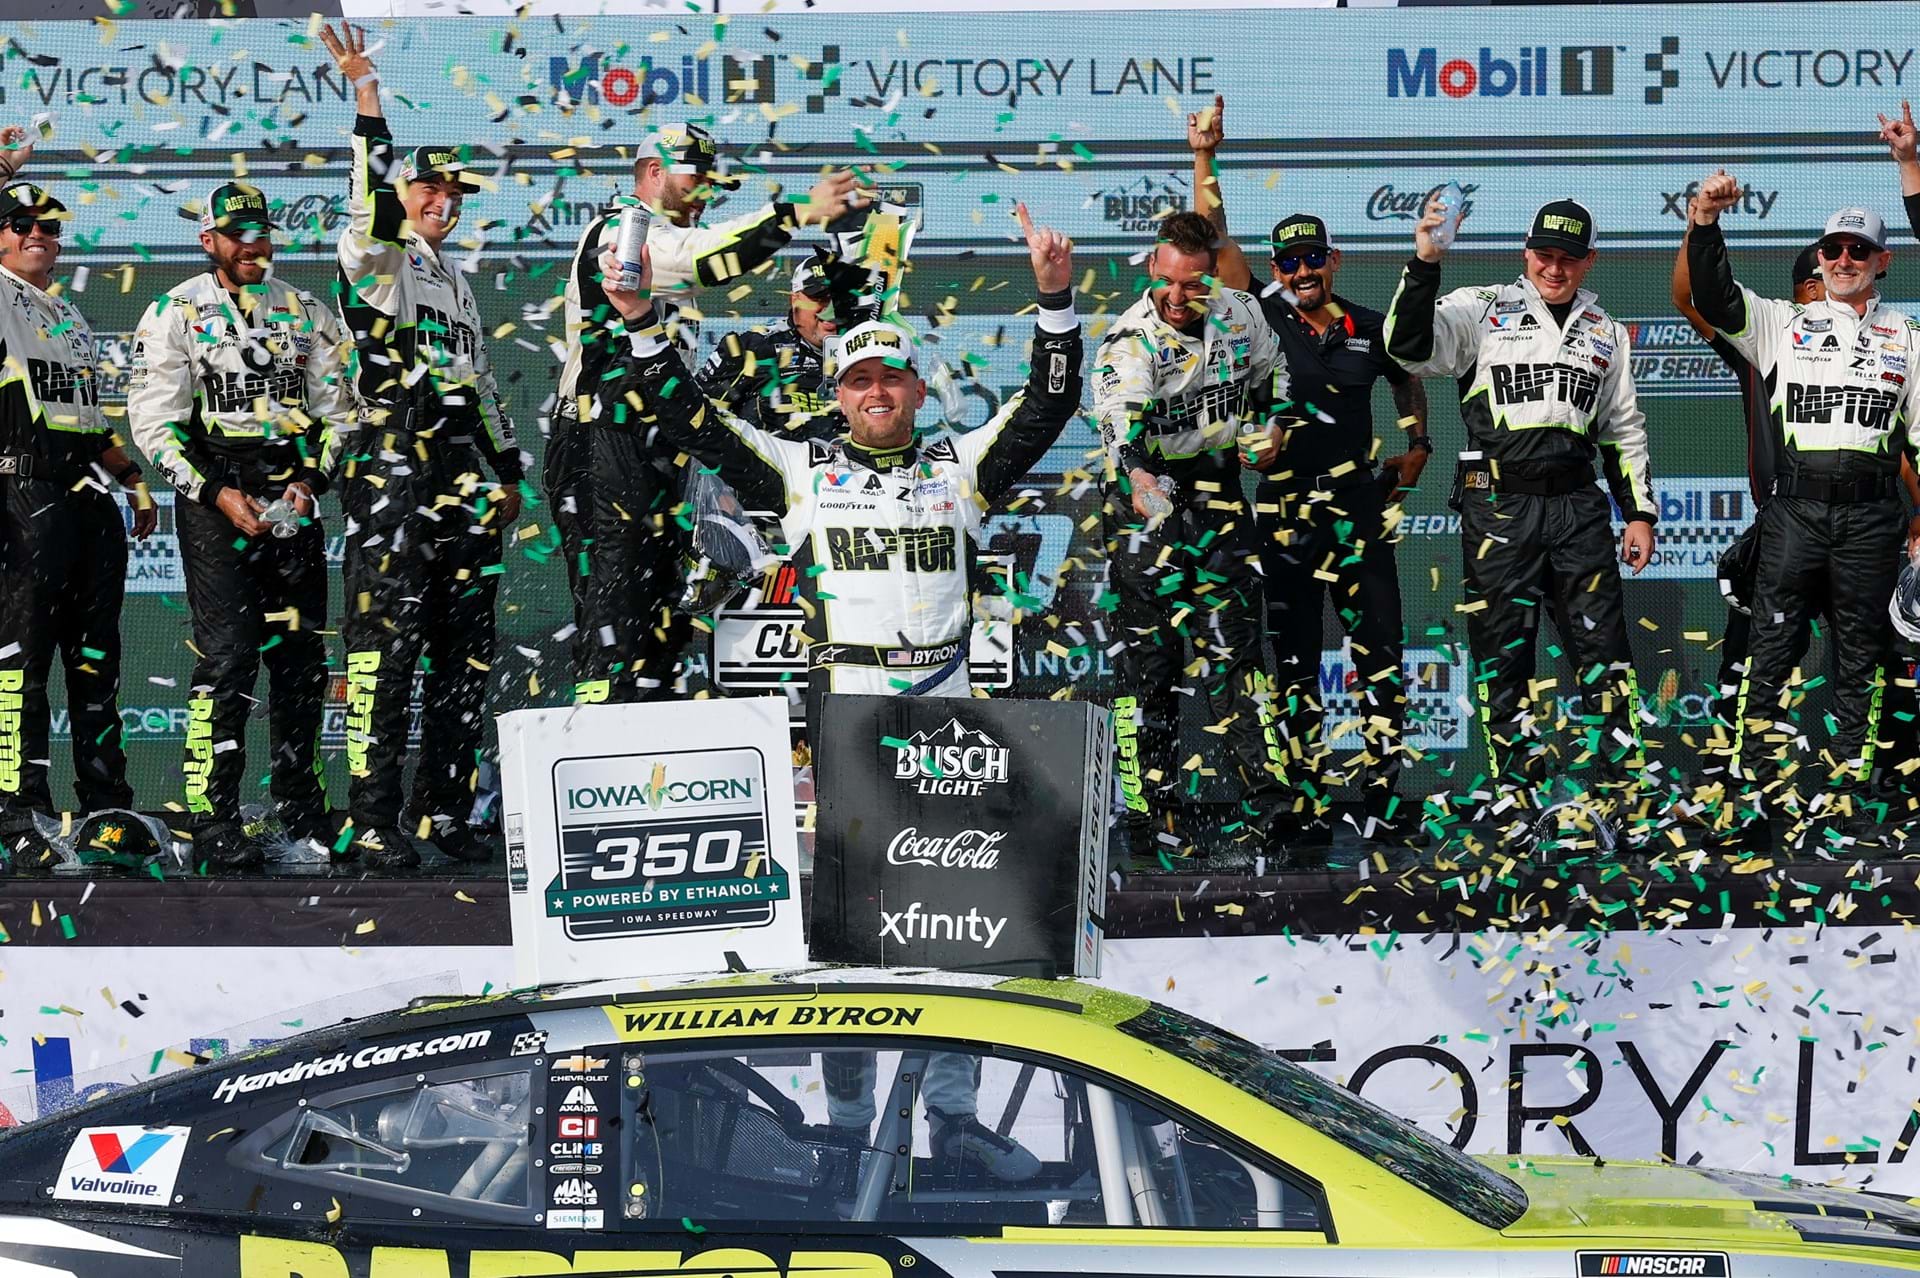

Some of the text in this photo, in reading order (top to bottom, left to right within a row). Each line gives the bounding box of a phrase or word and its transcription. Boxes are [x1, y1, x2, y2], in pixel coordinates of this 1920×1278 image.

[549, 56, 709, 105] Mobil
[866, 56, 1215, 97] VICTORY LANE
[1386, 47, 1547, 98] Mobil
[1704, 48, 1914, 89] VICTORY
[31, 63, 357, 105] VICTORY LAN
[224, 195, 263, 211] RAPTOR
[1103, 195, 1187, 221] BUSCH
[1660, 181, 1778, 220] xfty
[1118, 219, 1162, 232] LIGH
[1278, 223, 1318, 240] RAPTOR
[1543, 215, 1584, 236] RAPTOR
[1490, 362, 1601, 414] RAPTOR
[1786, 382, 1899, 431] RAPTOR
[875, 455, 904, 468] RAPTOR
[823, 486, 851, 494] Valvoline
[916, 480, 948, 491] Hendrick
[820, 502, 876, 511] GOODYEAR
[825, 526, 956, 572] RAPTOR
[911, 645, 959, 665] BYRON
[183, 699, 215, 814] RAPTOR
[894, 744, 1010, 784] BUSCH
[1115, 696, 1150, 813] RAPTOR
[916, 779, 984, 796] LIGHT
[1089, 717, 1105, 840] SERIES
[568, 777, 752, 810] IOWA CORN
[100, 826, 124, 843] 24
[591, 830, 743, 881] 350
[887, 827, 1009, 870] Coca-Cola
[572, 883, 762, 908] POWERED BY ETHANOL
[621, 910, 718, 924] IOWA SPEEDWAY
[879, 903, 1008, 949] xfinity
[624, 1005, 925, 1033] WILLIAM BYRON
[561, 1118, 596, 1136] CI
[550, 1143, 603, 1155] CLIMB
[71, 1176, 158, 1196] Valvoline
[553, 1178, 598, 1197] MAC
[553, 1197, 598, 1205] TOOLS
[553, 1215, 597, 1223] SIEMENS
[1627, 1257, 1706, 1275] NASCAR
